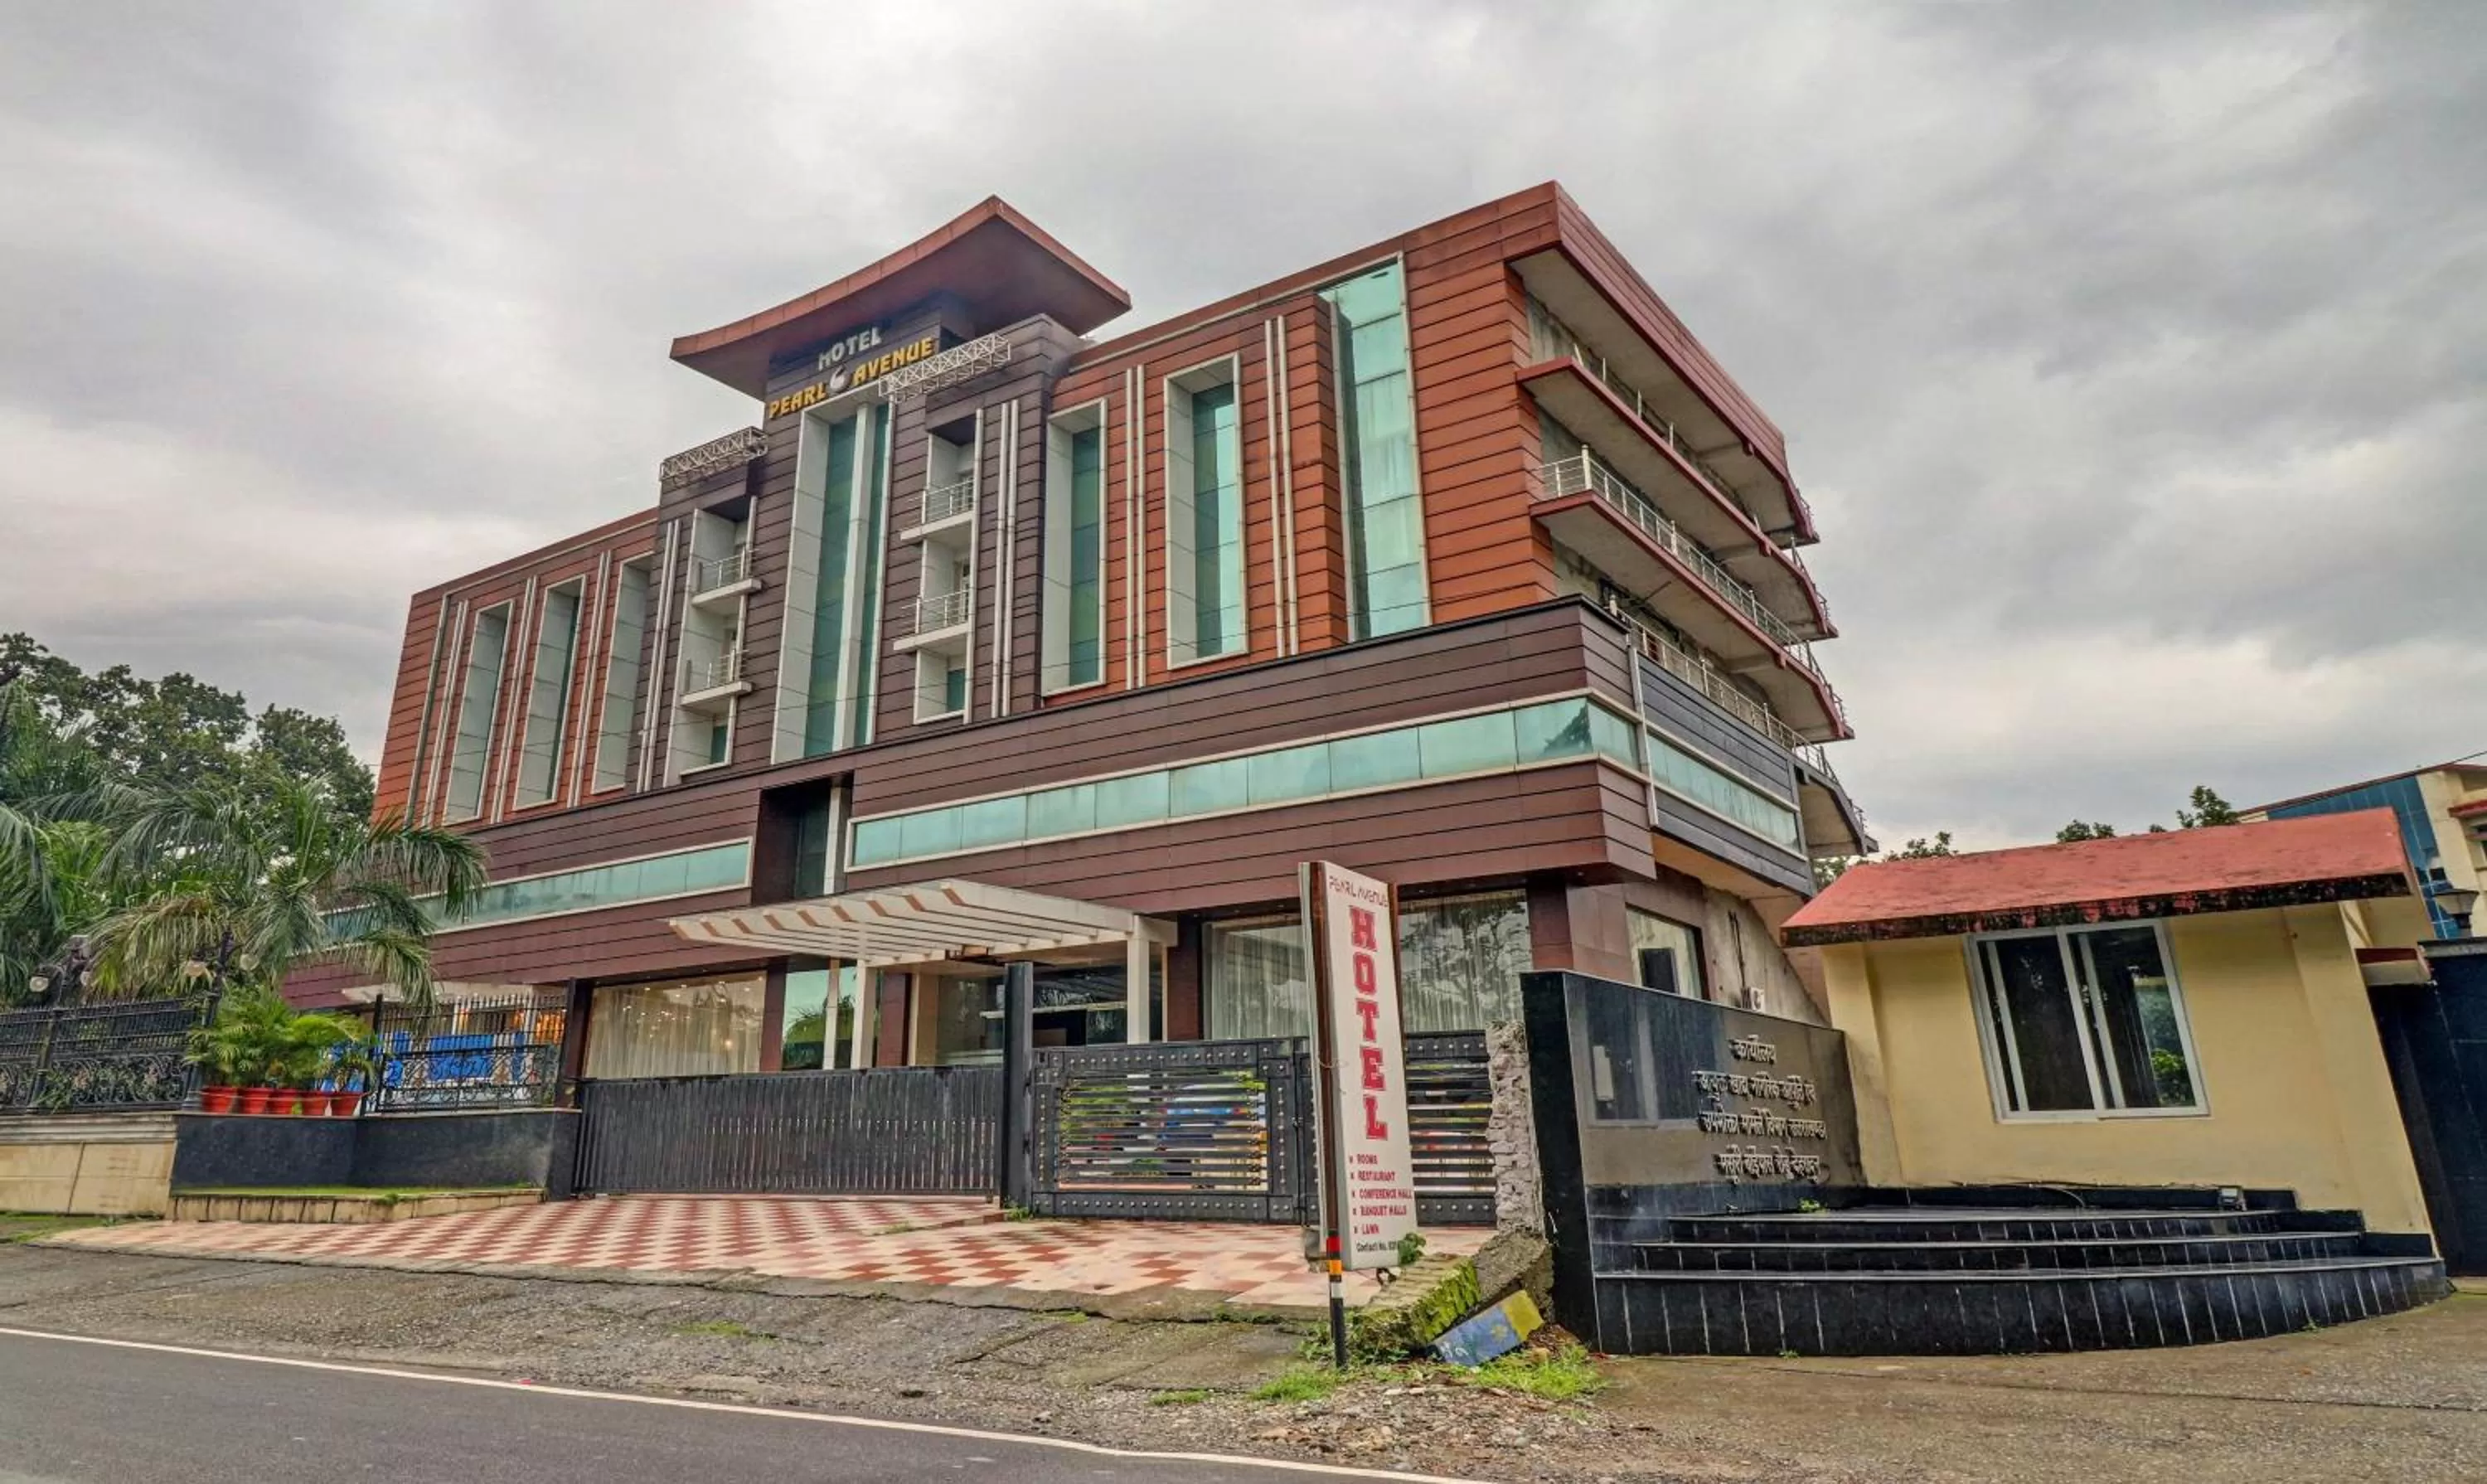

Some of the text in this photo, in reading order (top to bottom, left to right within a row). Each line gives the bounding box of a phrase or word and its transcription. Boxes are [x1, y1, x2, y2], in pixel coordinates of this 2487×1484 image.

[818, 327, 882, 371] HOTEL
[768, 337, 936, 419] PEARL AVENUE
[1329, 875, 1357, 898] PEARL
[1349, 904, 1389, 1141] HOTEL
[1728, 1034, 1777, 1065] कार्यालय
[1357, 1153, 1378, 1164] ROOMS
[1358, 1170, 1395, 1181] RESTAURANT
[1360, 1188, 1397, 1199] CONFERENCE
[1360, 1205, 1387, 1216] BANQUET
[1362, 1223, 1380, 1234] LAWN
